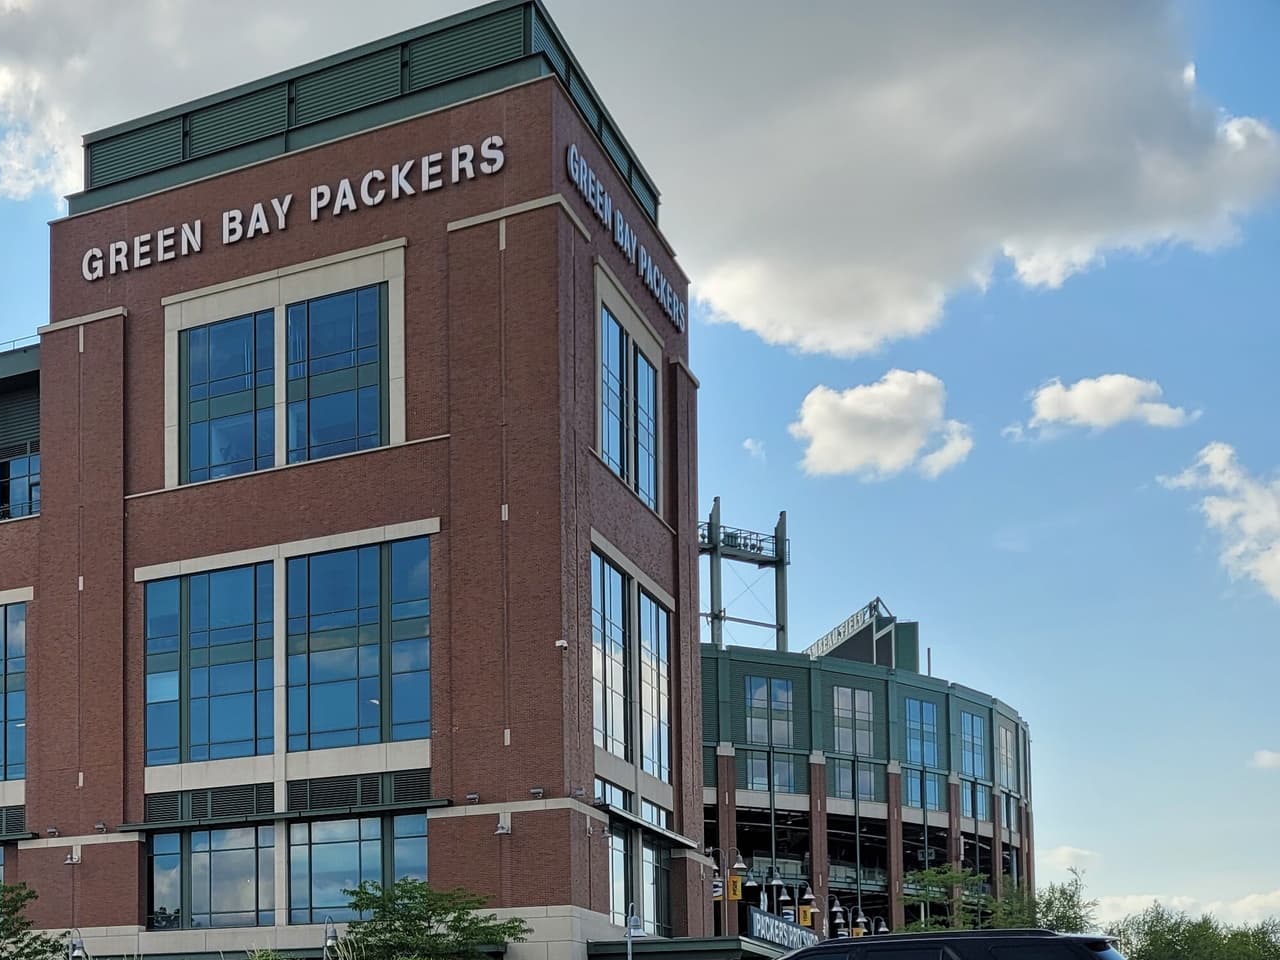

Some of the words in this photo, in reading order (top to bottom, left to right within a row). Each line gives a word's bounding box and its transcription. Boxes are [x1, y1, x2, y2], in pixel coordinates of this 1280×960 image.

[81, 219, 203, 282] GREEN
[222, 193, 293, 246] BAY
[310, 134, 506, 222] PACKERS
[567, 143, 612, 231] GREEN
[614, 208, 638, 265] BAY
[637, 244, 686, 334] PACKERS
[753, 911, 788, 946] PACKERS
